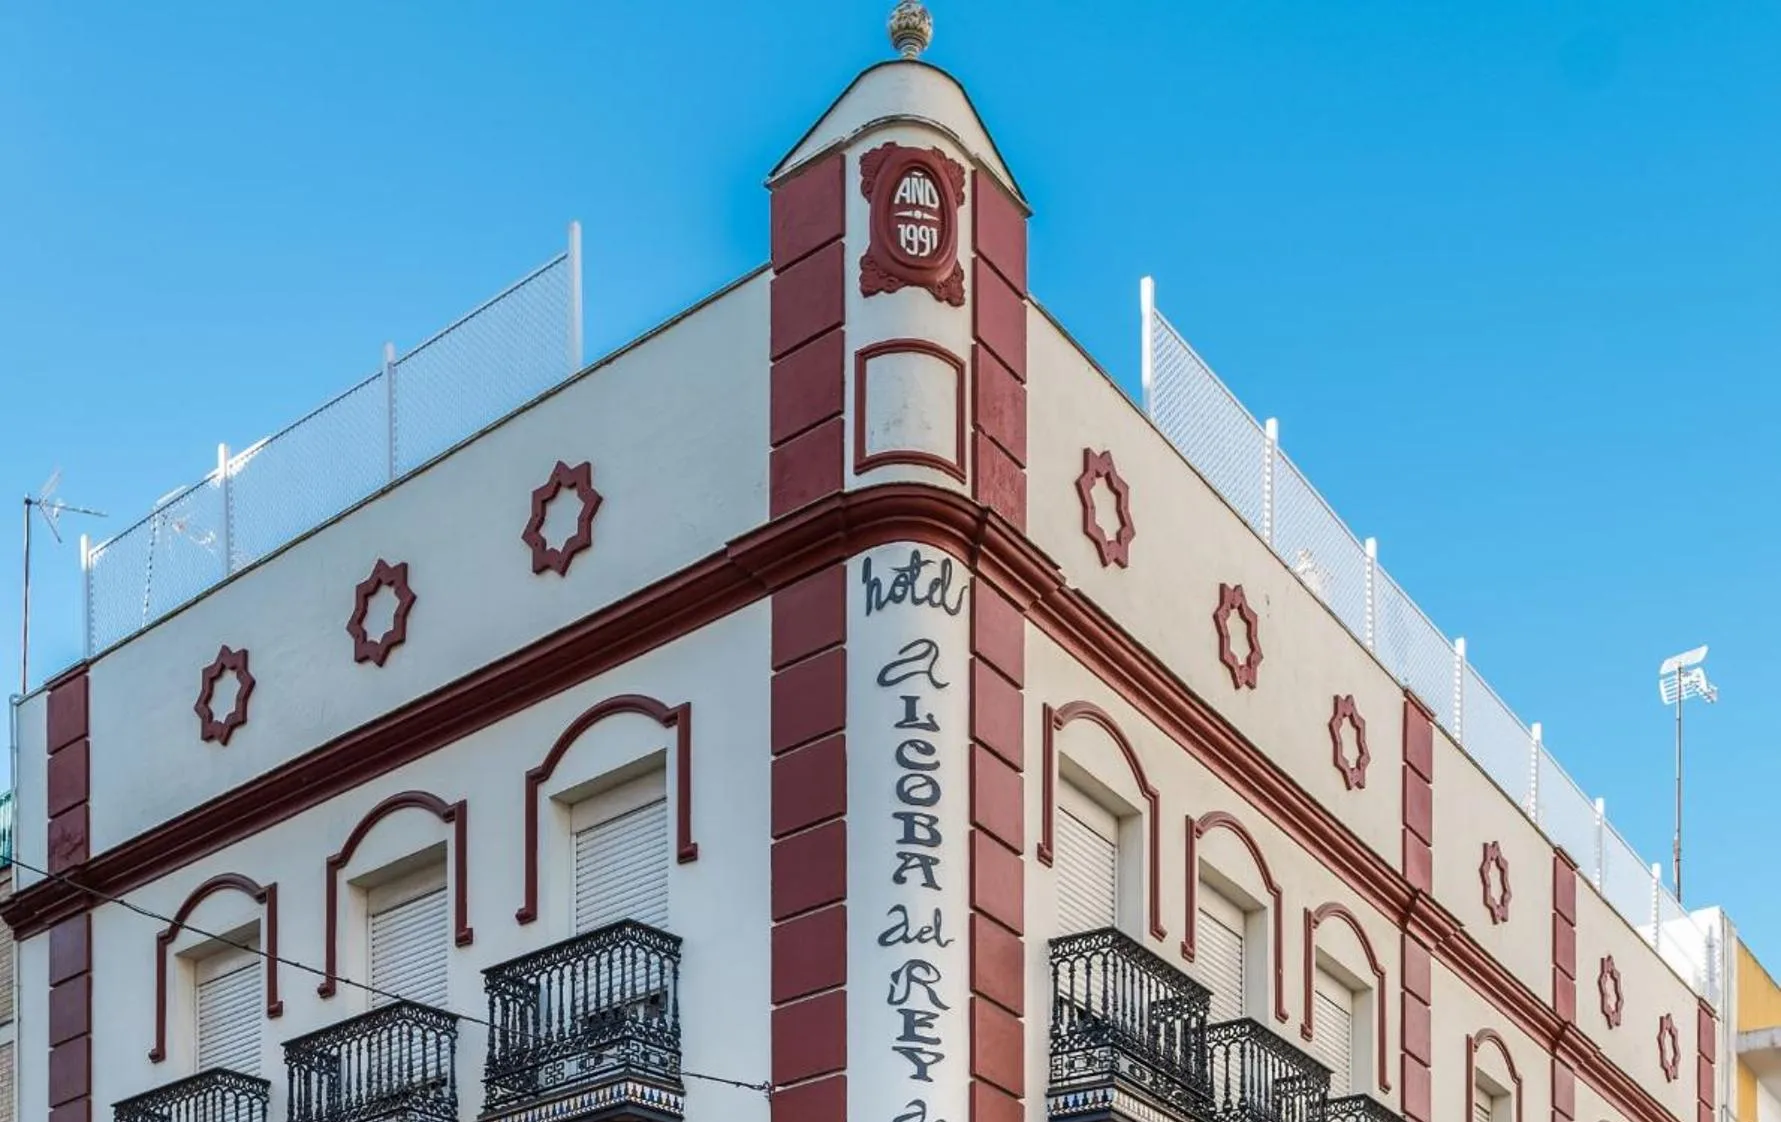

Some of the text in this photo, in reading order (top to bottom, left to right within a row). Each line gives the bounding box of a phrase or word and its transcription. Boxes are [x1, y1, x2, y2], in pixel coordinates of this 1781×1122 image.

[894, 171, 940, 208] AÑO
[897, 224, 939, 257] 1991
[862, 549, 968, 617] hotel
[886, 958, 950, 1083] REY
